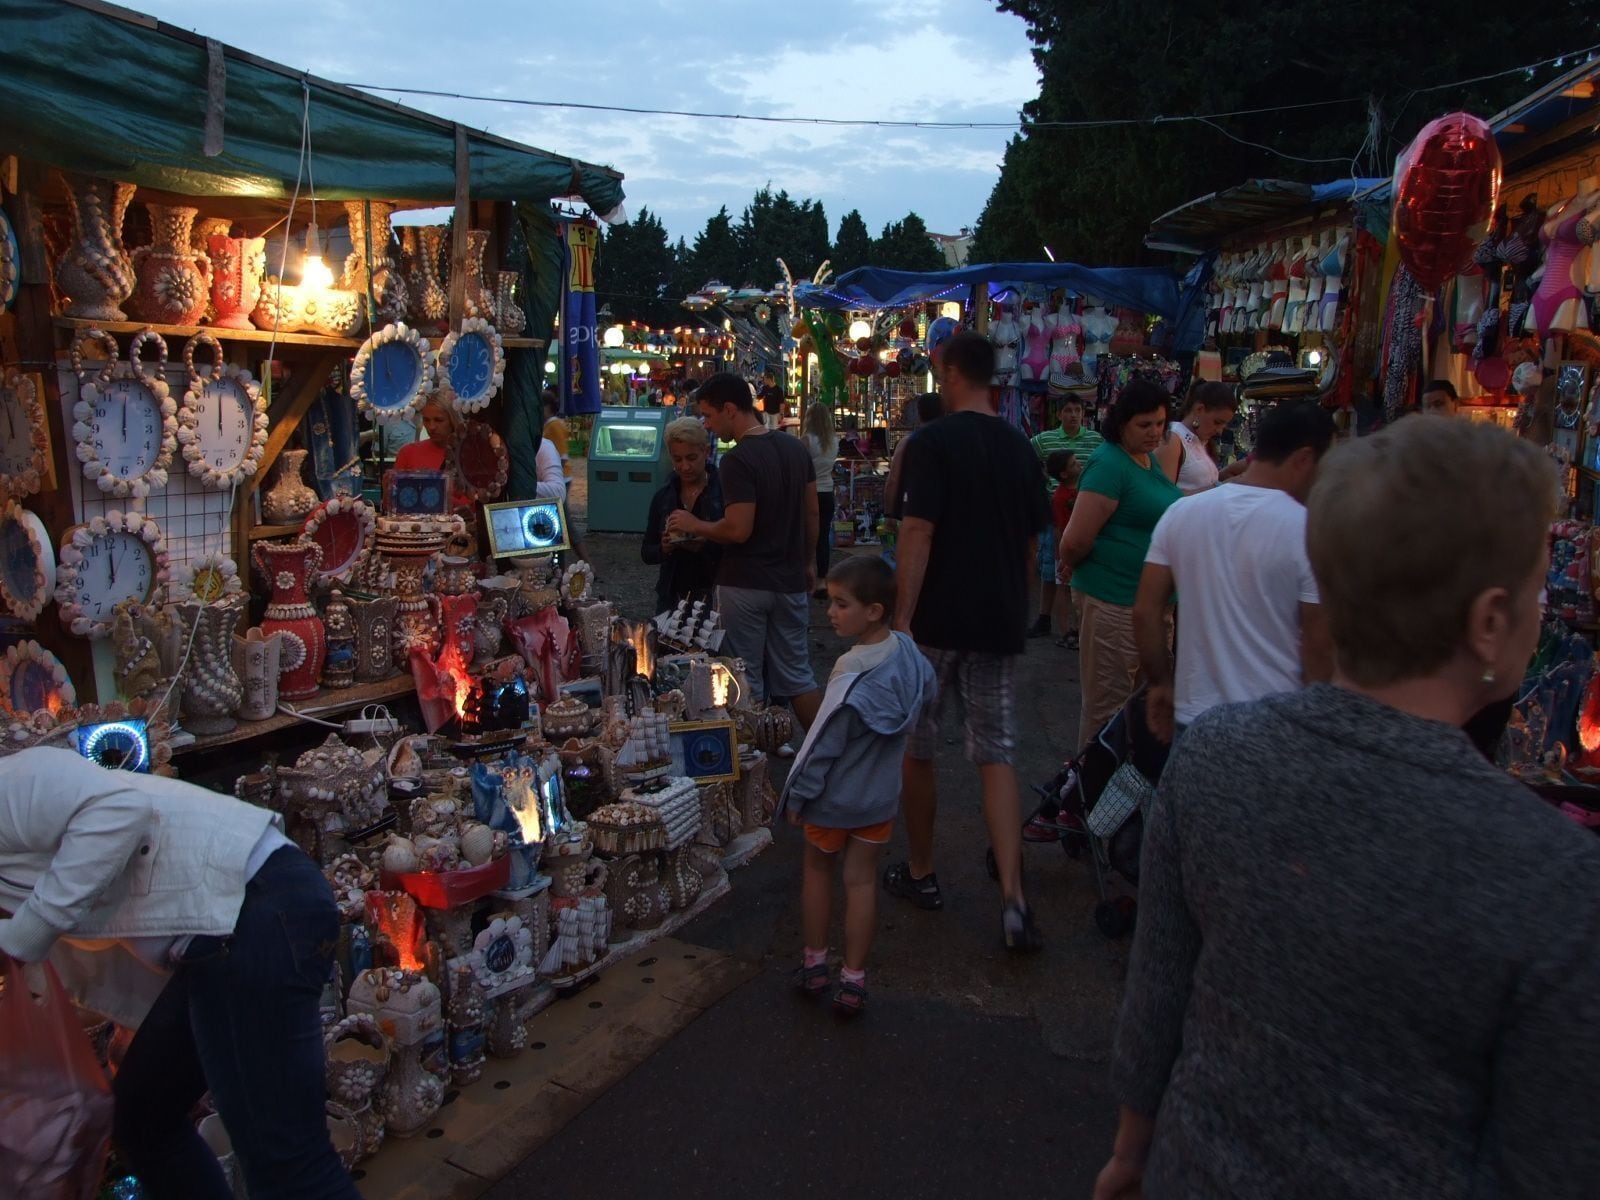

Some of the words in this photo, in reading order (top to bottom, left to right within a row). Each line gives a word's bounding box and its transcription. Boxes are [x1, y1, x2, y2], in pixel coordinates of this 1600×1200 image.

[450, 355, 459, 372] 9
[475, 348, 490, 381] 3
[119, 383, 129, 392] 12
[217, 380, 226, 389] 12
[103, 393, 112, 402] 11
[203, 389, 210, 399] 11
[95, 409, 106, 418] 10
[144, 408, 152, 417] 2
[196, 405, 205, 414] 10
[237, 405, 244, 413] 2
[92, 424, 100, 434] 9
[145, 425, 153, 434] 3
[238, 420, 245, 429] 3
[95, 440, 103, 449] 8
[236, 435, 241, 444] 4
[143, 441, 151, 450] 4
[202, 449, 208, 459] 7
[229, 449, 236, 458] 5
[104, 457, 111, 467] 7
[137, 456, 144, 466] 5
[216, 458, 222, 467] 6
[121, 466, 128, 476] 6
[104, 537, 116, 550] 12
[123, 540, 127, 550] 1
[90, 546, 99, 557] 11
[134, 549, 141, 561] 2
[138, 565, 145, 576] 3
[75, 577, 84, 590] 9
[136, 582, 143, 592] 4
[82, 593, 91, 605] 8
[94, 602, 102, 615] 7
